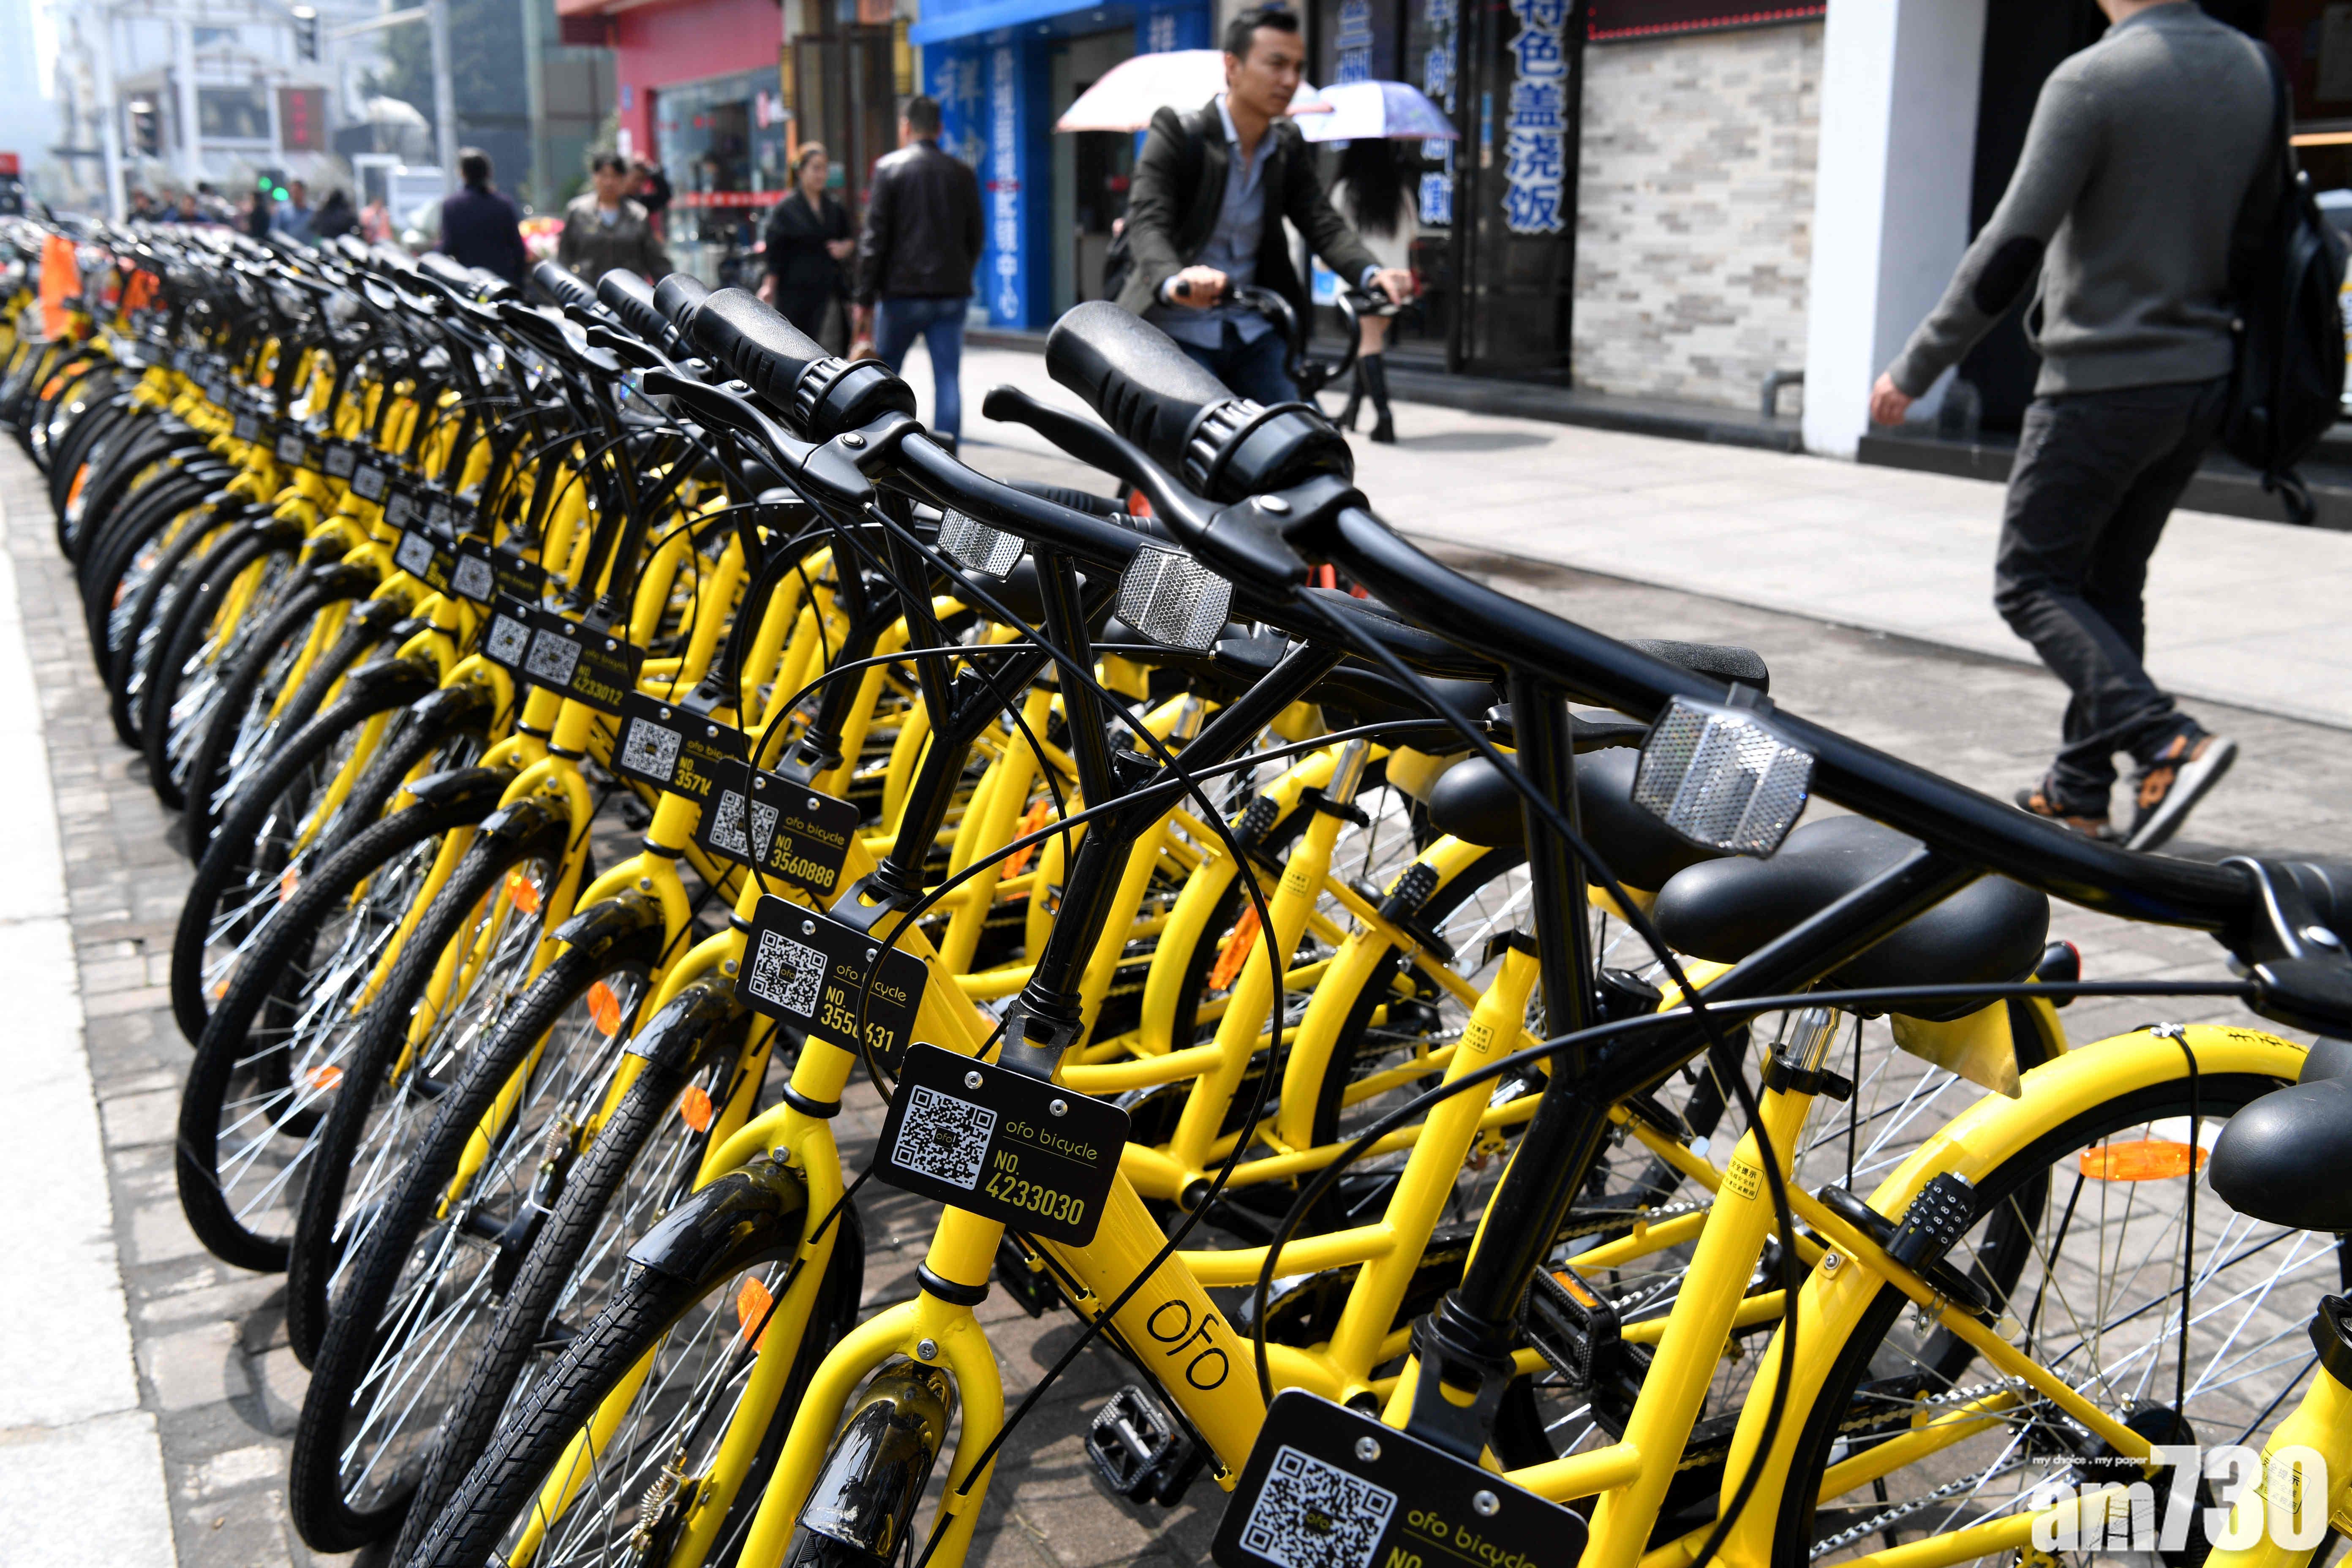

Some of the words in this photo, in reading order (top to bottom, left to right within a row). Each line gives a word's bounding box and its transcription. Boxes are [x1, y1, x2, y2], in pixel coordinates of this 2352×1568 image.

[572, 676, 623, 706] 4233012
[686, 740, 704, 753] ofo
[706, 745, 739, 760] bic
[774, 834, 793, 853] NO.
[785, 817, 805, 830] ofo
[807, 822, 845, 845] bicycle
[770, 849, 835, 888] 3560888
[781, 969, 795, 979] ofo
[836, 965, 858, 980] ofo
[862, 972, 906, 1002] icycle
[825, 985, 846, 1008] NO.
[936, 1132, 953, 1143] ofo
[1006, 1121, 1034, 1139] ofo
[1040, 1129, 1098, 1160] bicycle
[994, 1150, 1020, 1176] NO.
[985, 1173, 1085, 1225] 4233030
[1911, 1216, 1920, 1224] 8
[1919, 1206, 1928, 1214] 7
[1926, 1196, 1935, 1204] 7
[1933, 1185, 1942, 1193] 5
[1960, 1204, 1967, 1212] 7
[1925, 1225, 1935, 1234] 9
[1933, 1216, 1943, 1225] 8
[1941, 1206, 1950, 1214] 8
[1947, 1194, 1956, 1203] 6
[1146, 1298, 1229, 1391] ofo
[1306, 1513, 1330, 1530] ofo
[1407, 1510, 1448, 1538] ofo
